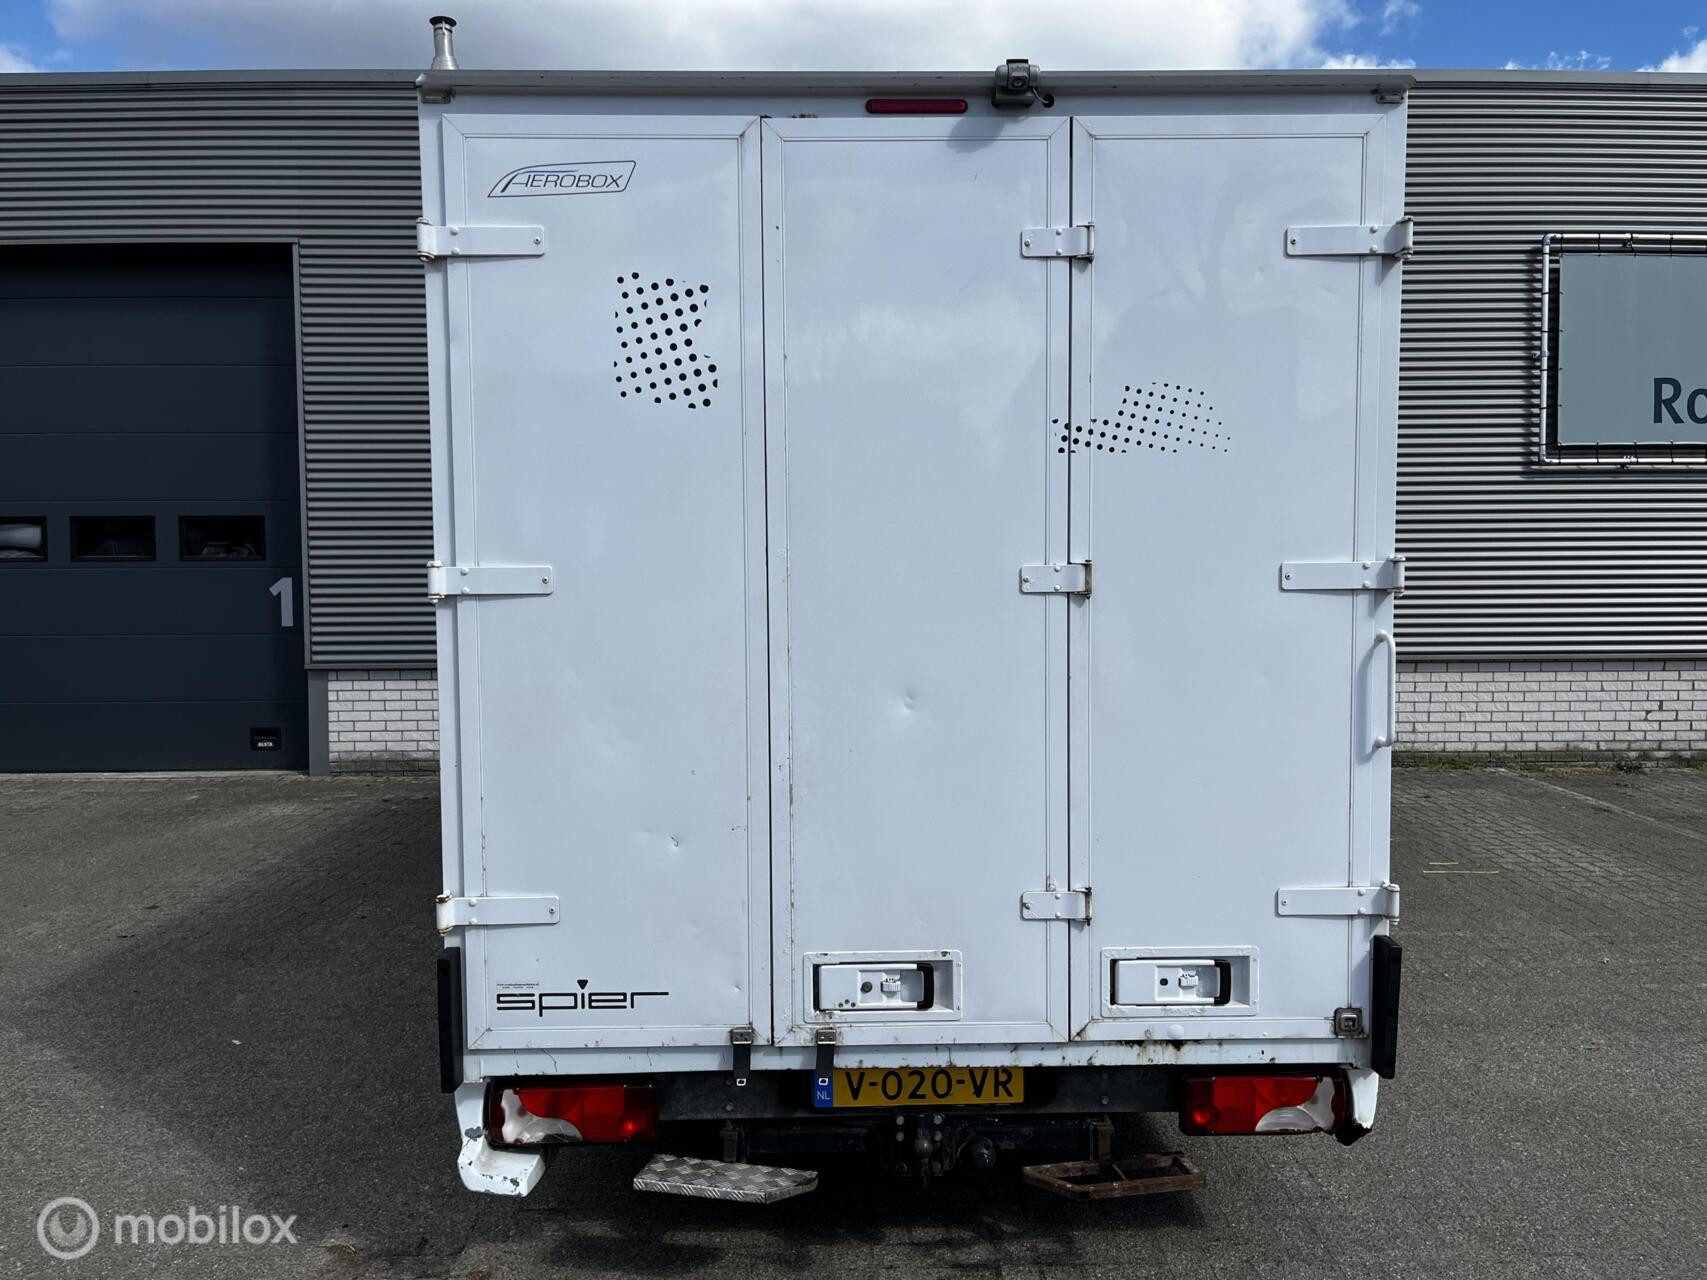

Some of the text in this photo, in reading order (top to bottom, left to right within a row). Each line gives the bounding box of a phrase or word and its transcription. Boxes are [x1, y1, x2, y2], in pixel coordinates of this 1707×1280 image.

[501, 170, 623, 193] AEROBOX
[269, 577, 294, 627] 1
[496, 979, 669, 1017] spier
[817, 1091, 830, 1100] NL
[845, 1068, 1014, 1101] V-020-VR
